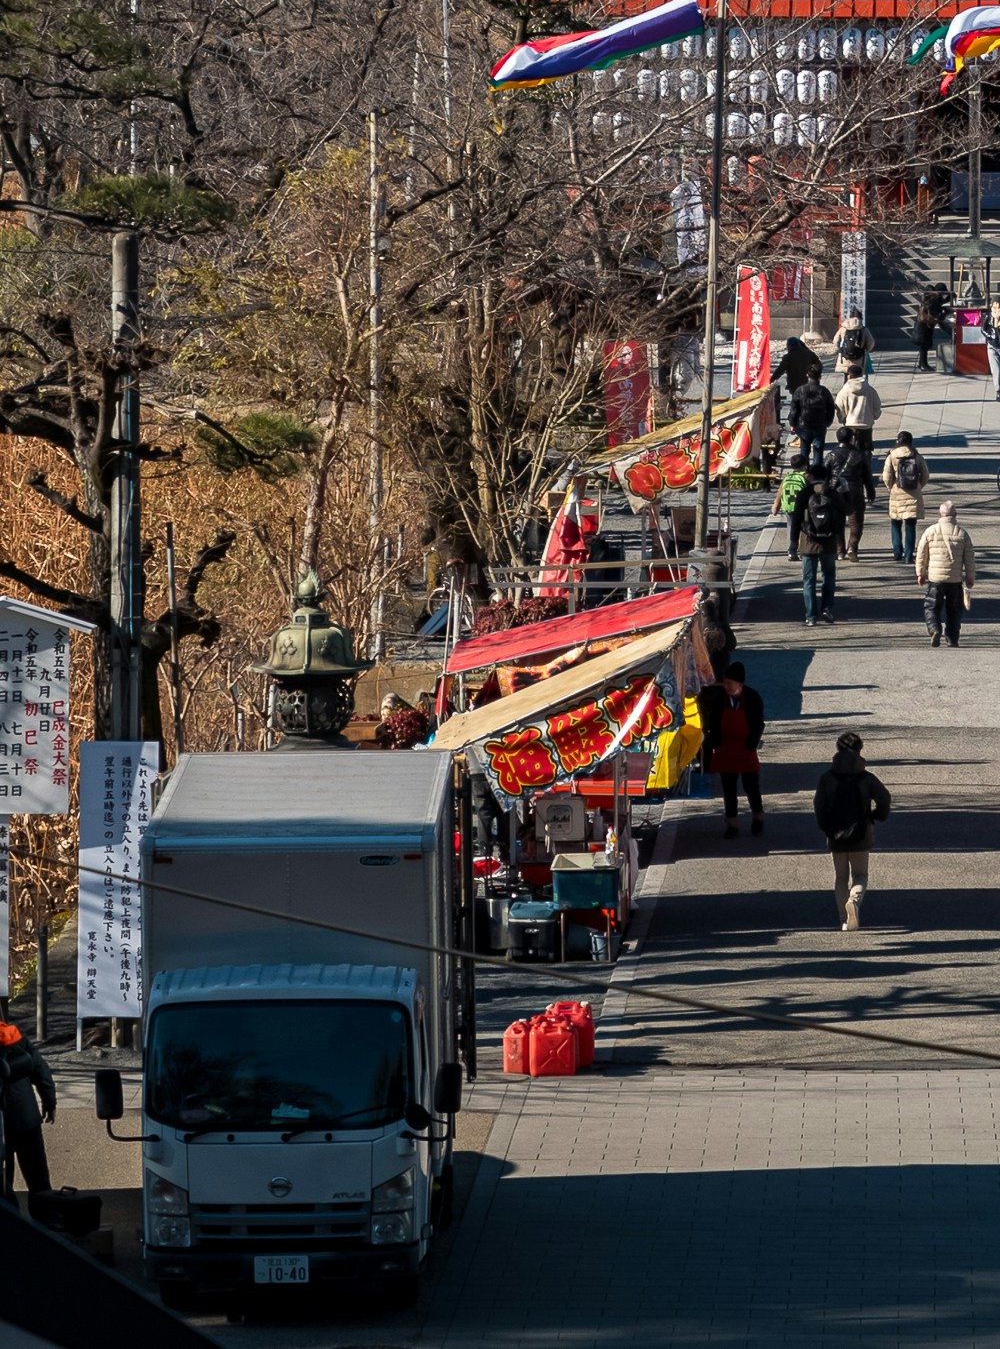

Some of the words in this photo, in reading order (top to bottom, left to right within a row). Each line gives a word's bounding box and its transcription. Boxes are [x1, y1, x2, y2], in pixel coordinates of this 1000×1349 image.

[25, 627, 39, 681] 令和五年
[53, 628, 67, 681] 令和五年
[39, 667, 52, 733] 九月廿日
[11, 722, 23, 797] 七月十日
[51, 700, 67, 786] 巳成金大祭
[484, 673, 675, 796] 海鮮焼
[332, 1191, 367, 1200] ATLAS
[269, 1266, 306, 1282] 10-40
